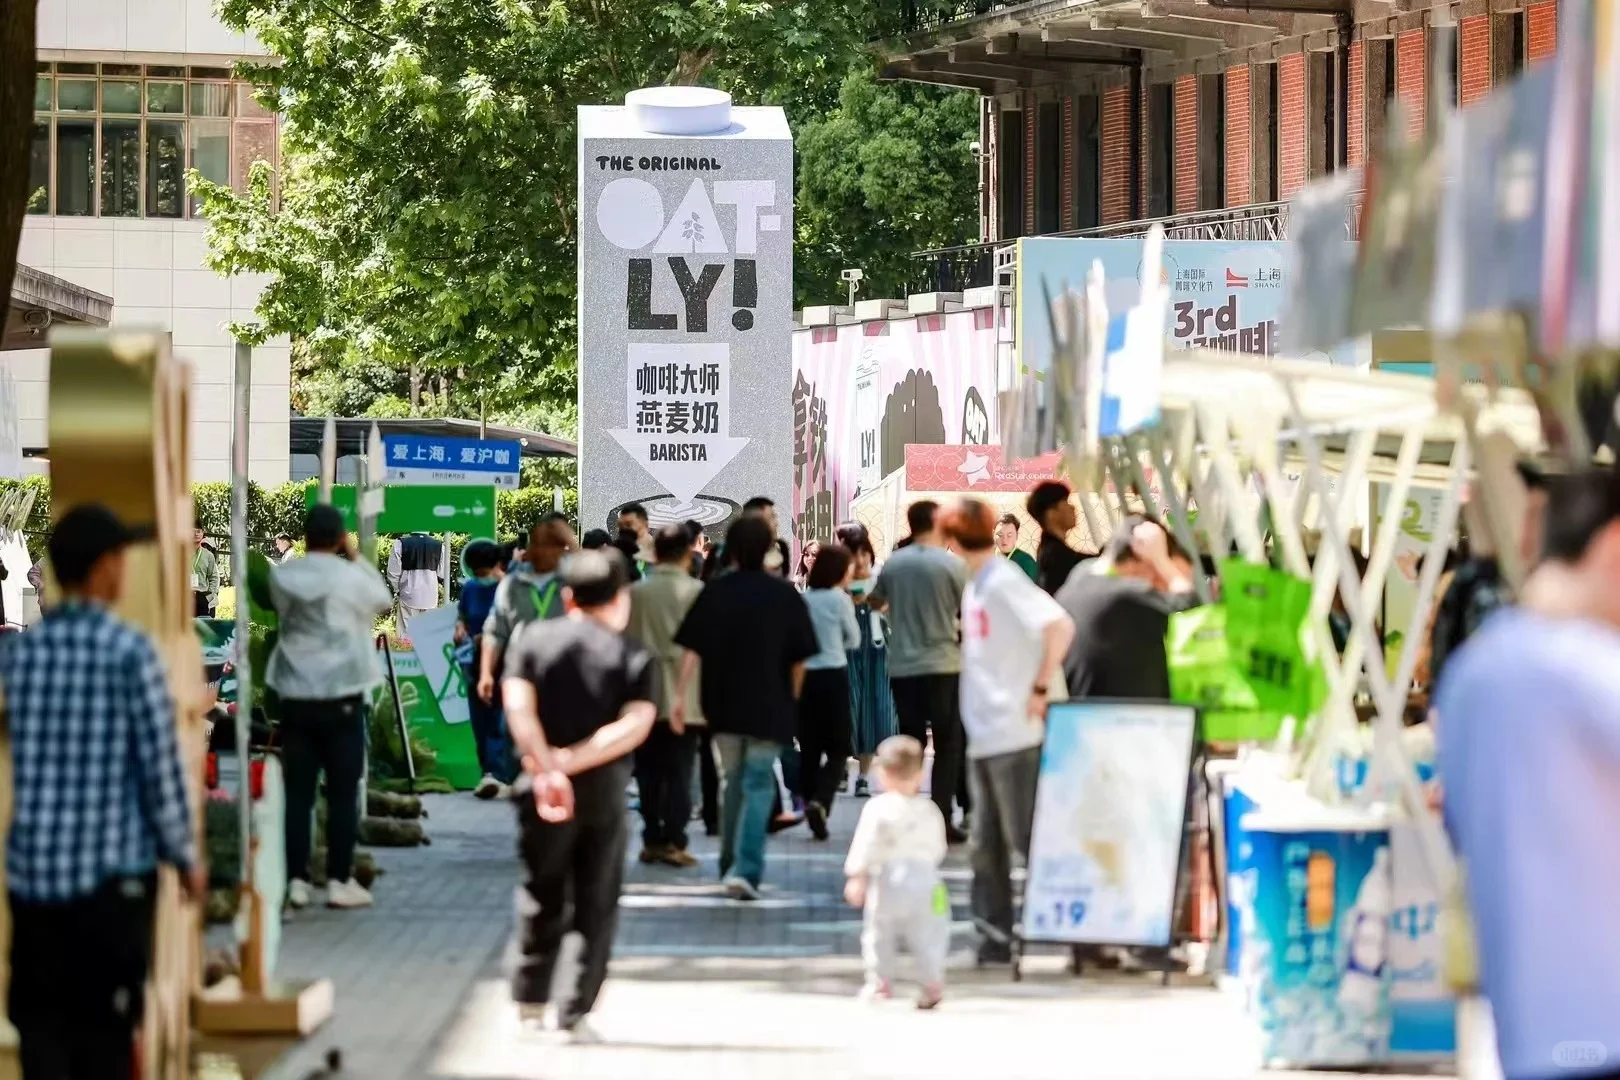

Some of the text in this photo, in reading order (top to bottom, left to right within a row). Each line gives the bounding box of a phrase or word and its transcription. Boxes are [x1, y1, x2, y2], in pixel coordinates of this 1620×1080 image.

[595, 155, 722, 171] THE ORIGINAL
[626, 256, 758, 333] LY!
[1173, 294, 1237, 338] 3rd
[636, 362, 720, 396] 咖啡大师
[636, 400, 719, 434] 燕麦奶
[649, 443, 708, 462] BARISTA
[861, 428, 875, 469] LY!
